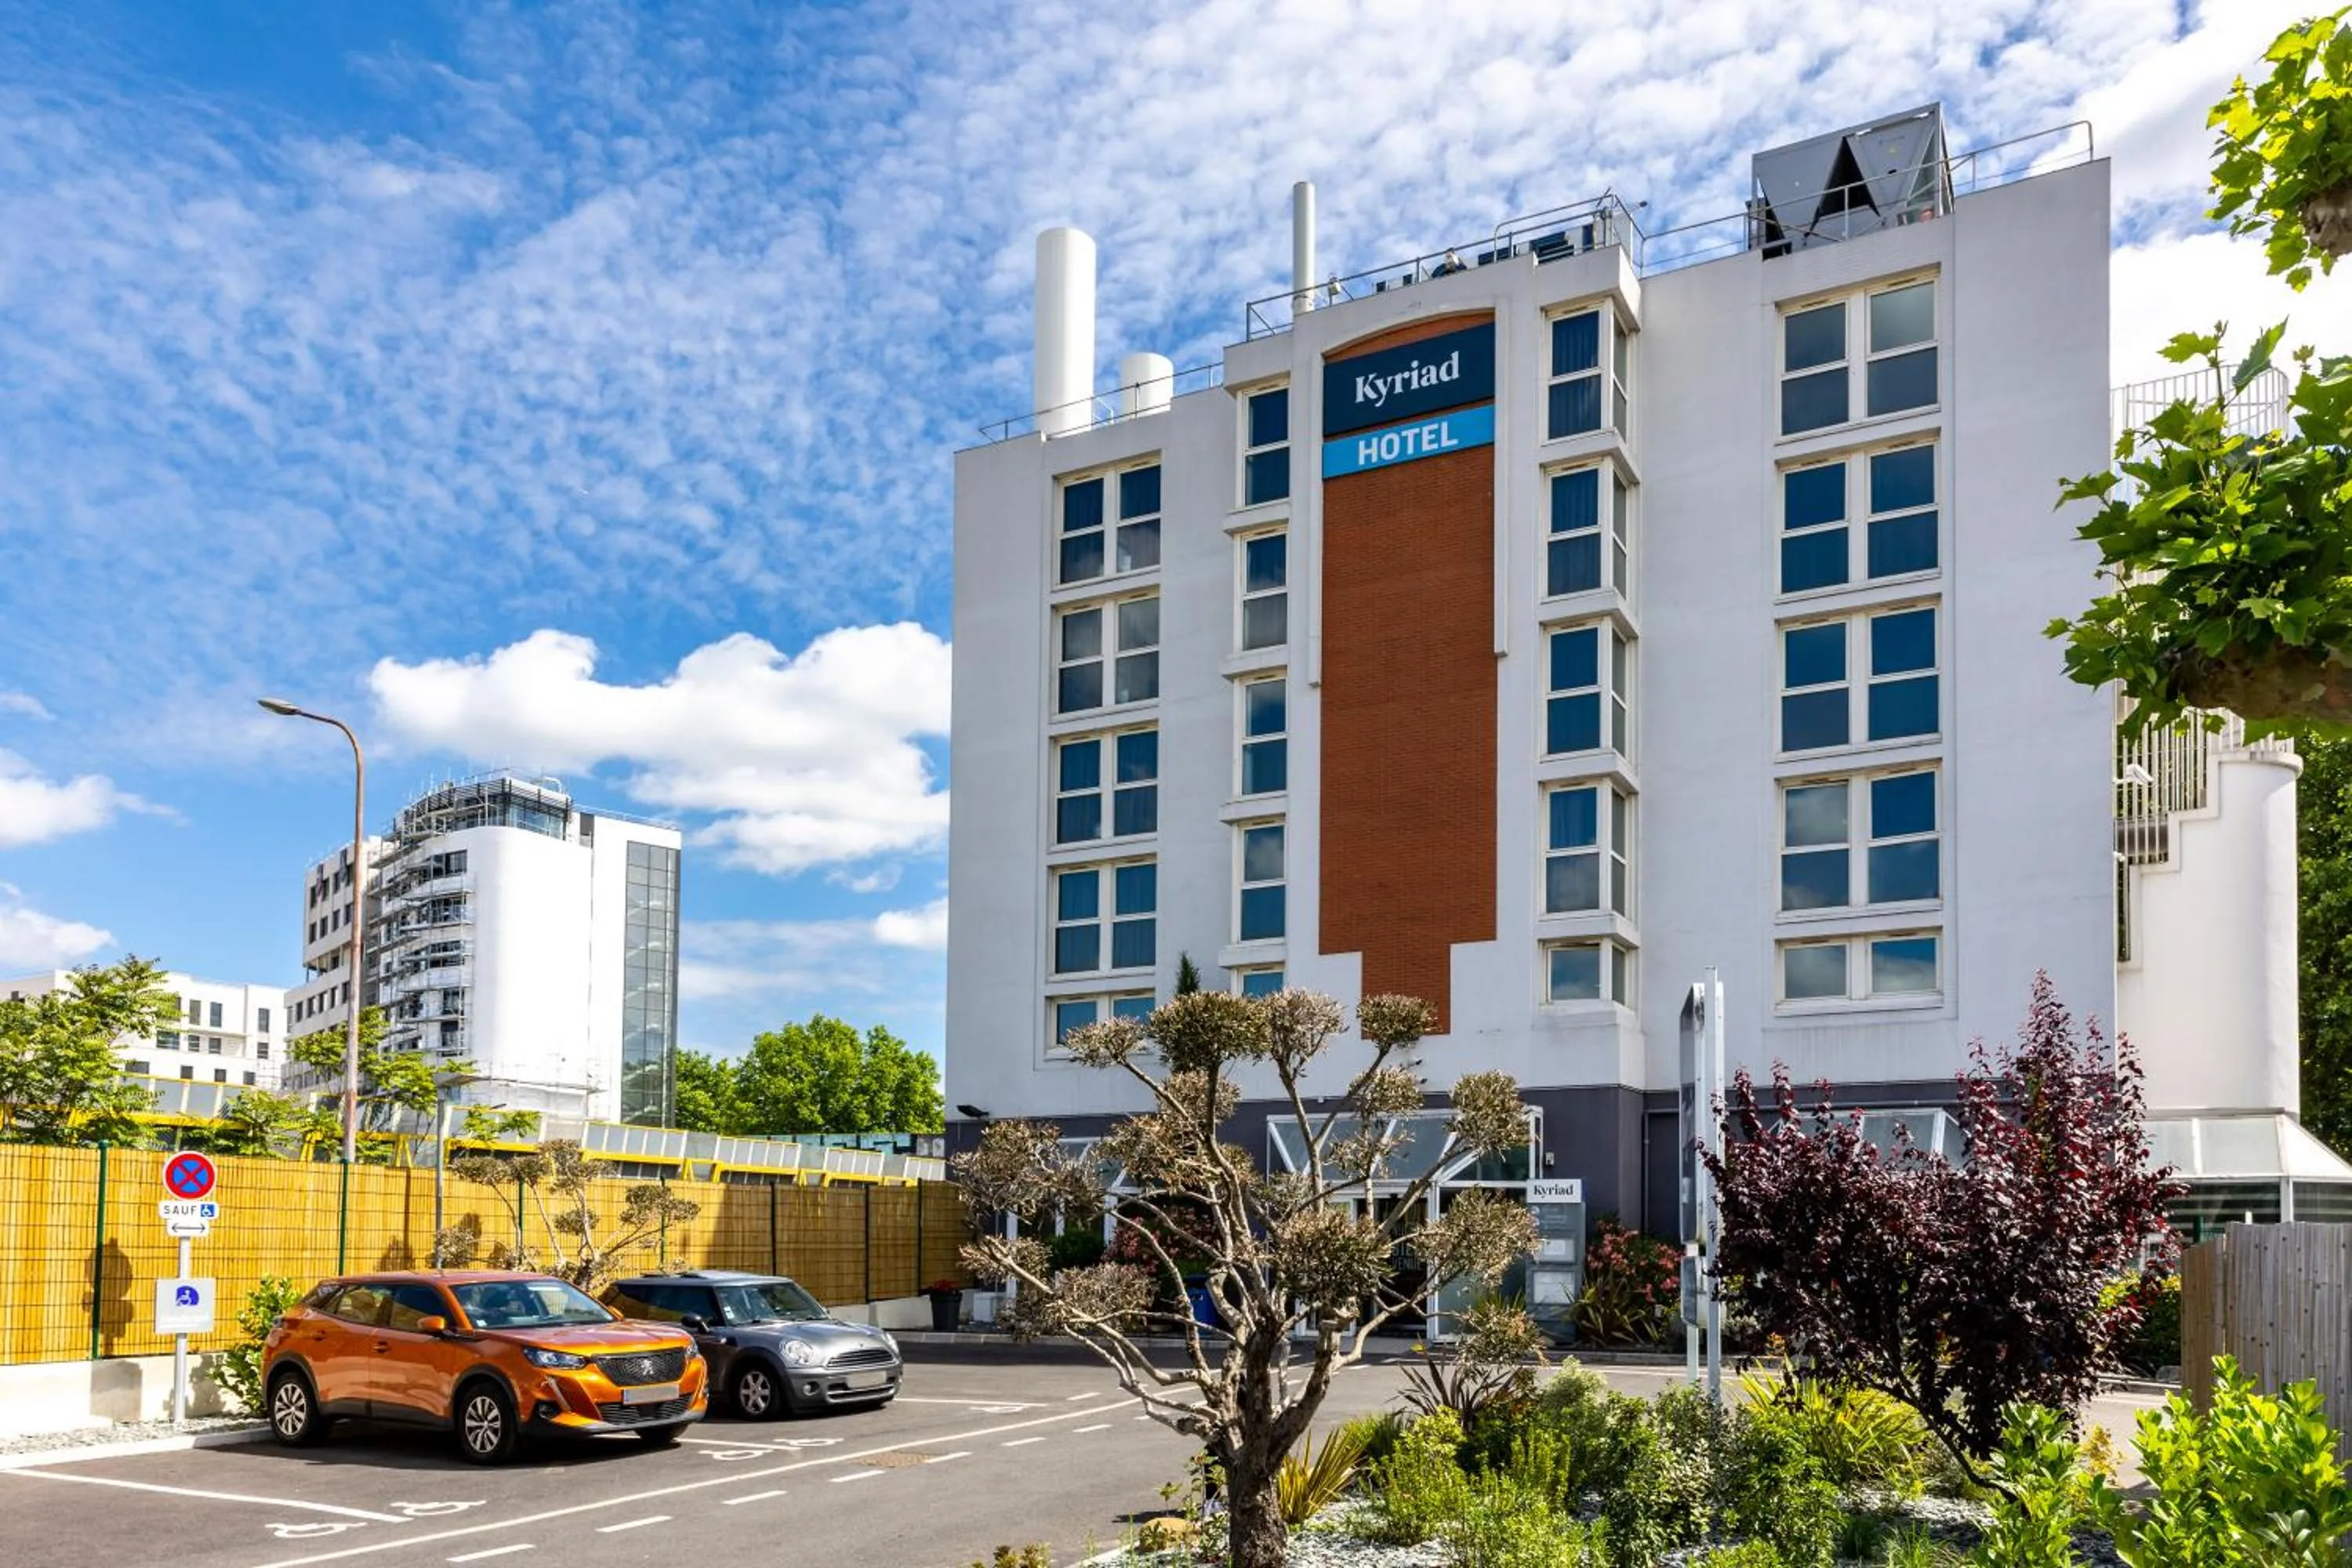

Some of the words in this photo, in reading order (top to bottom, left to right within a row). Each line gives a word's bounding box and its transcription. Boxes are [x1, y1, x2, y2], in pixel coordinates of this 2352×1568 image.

[1355, 351, 1459, 407] Kyriad
[1358, 421, 1458, 465] HOTEL
[1534, 1184, 1573, 1198] Kyriad
[163, 1205, 197, 1215] SAUF
